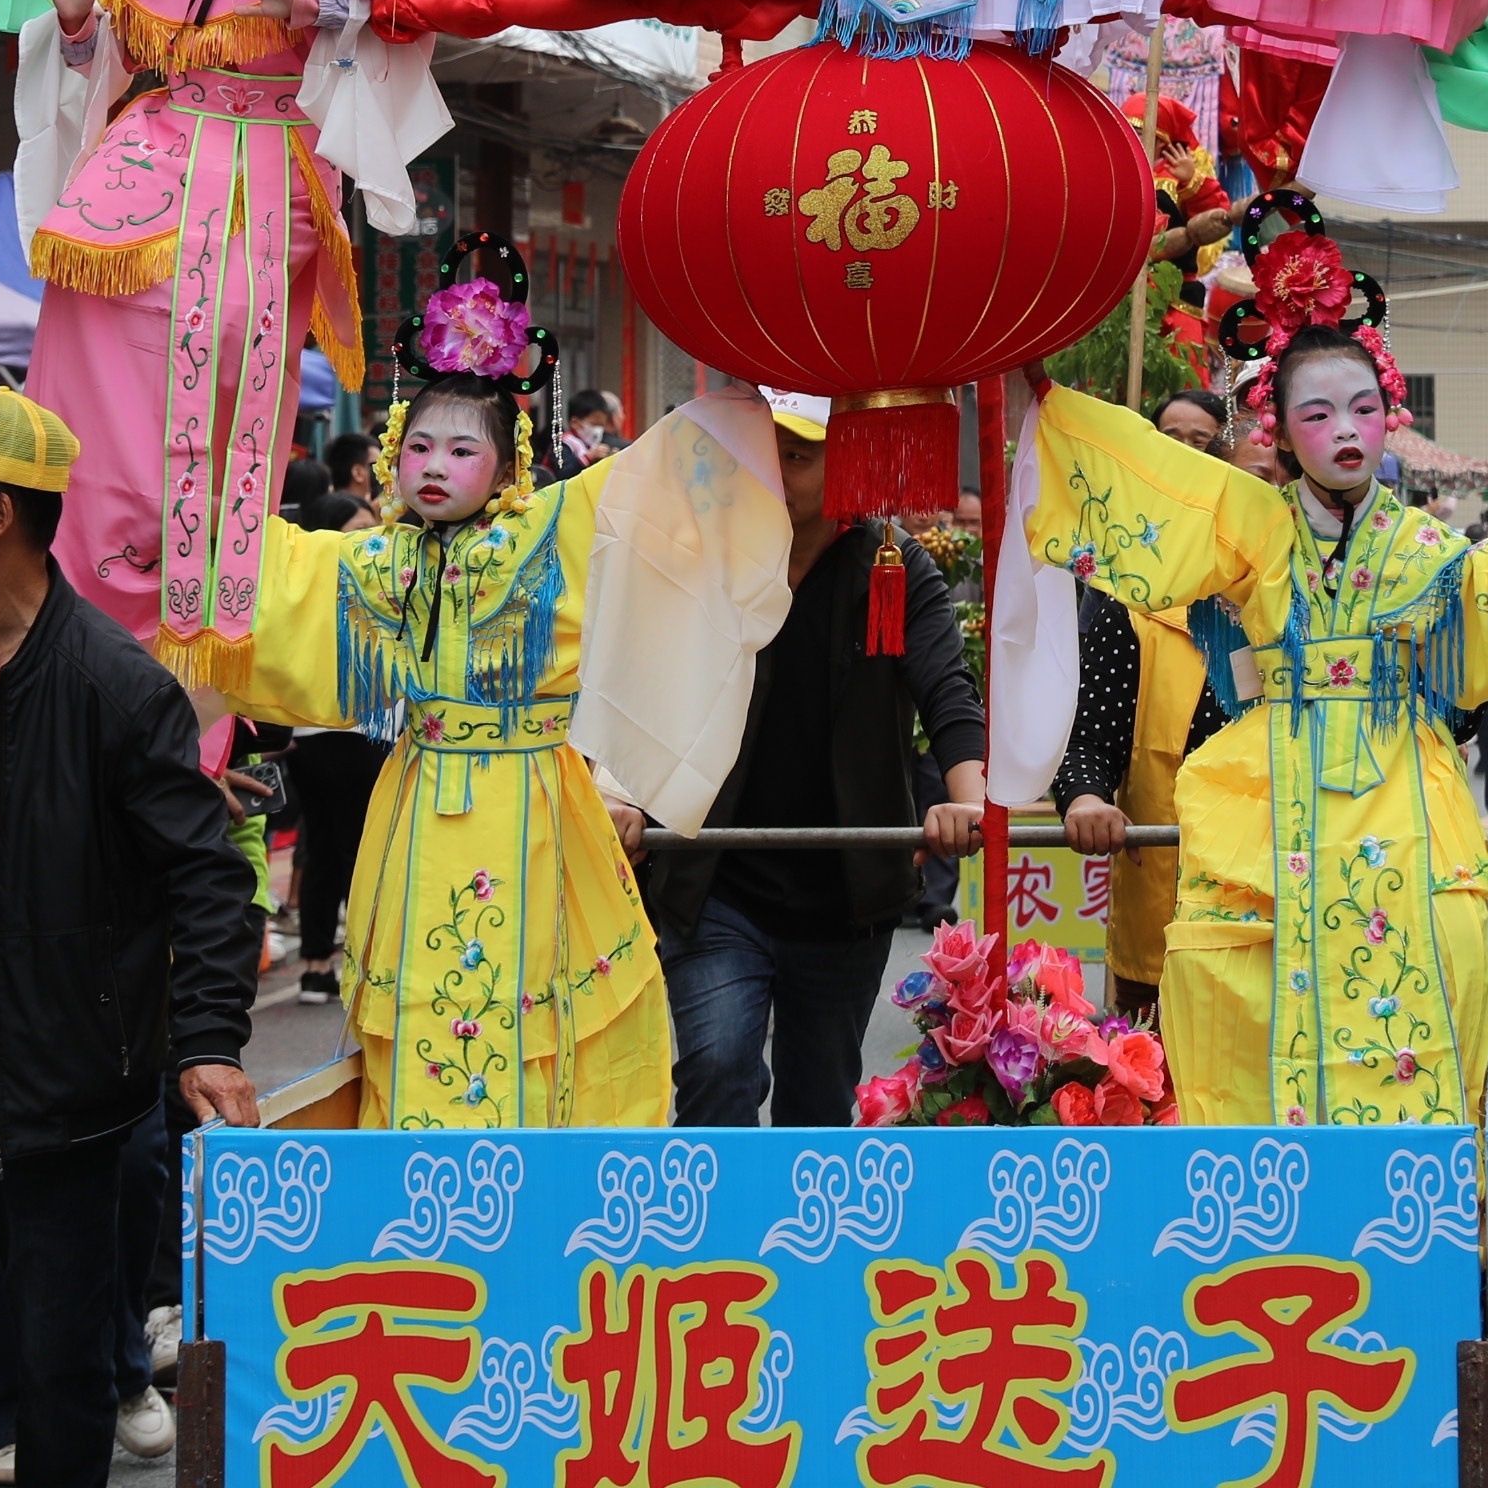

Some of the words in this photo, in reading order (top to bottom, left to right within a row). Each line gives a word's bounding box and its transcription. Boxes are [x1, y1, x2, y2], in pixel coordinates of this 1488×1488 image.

[847, 109, 878, 134] 恭
[798, 144, 920, 251] 福
[927, 180, 960, 209] 財
[844, 262, 874, 289] 喜
[261, 1249, 1416, 1488] 天姬送子
